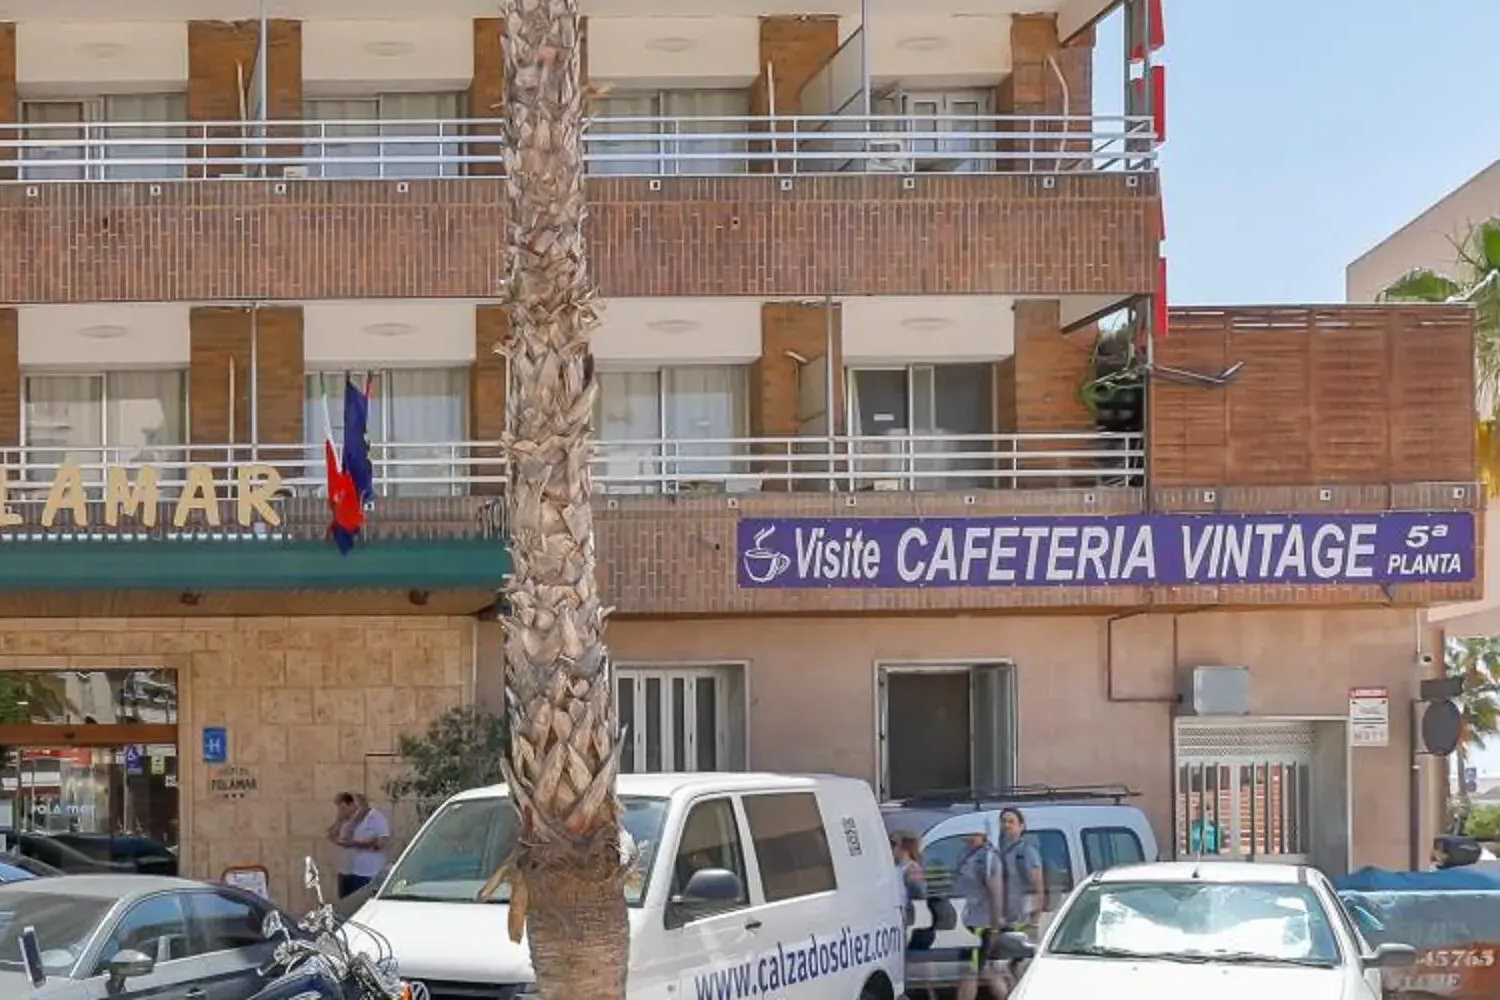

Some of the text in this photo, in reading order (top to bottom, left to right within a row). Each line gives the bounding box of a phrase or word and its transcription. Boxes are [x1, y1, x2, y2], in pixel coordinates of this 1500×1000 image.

[795, 523, 1377, 581] Visite CAFETERIA VINTAGE
[1387, 552, 1462, 576] PLANTA
[694, 925, 902, 1000] www.calzadosdiez.com
